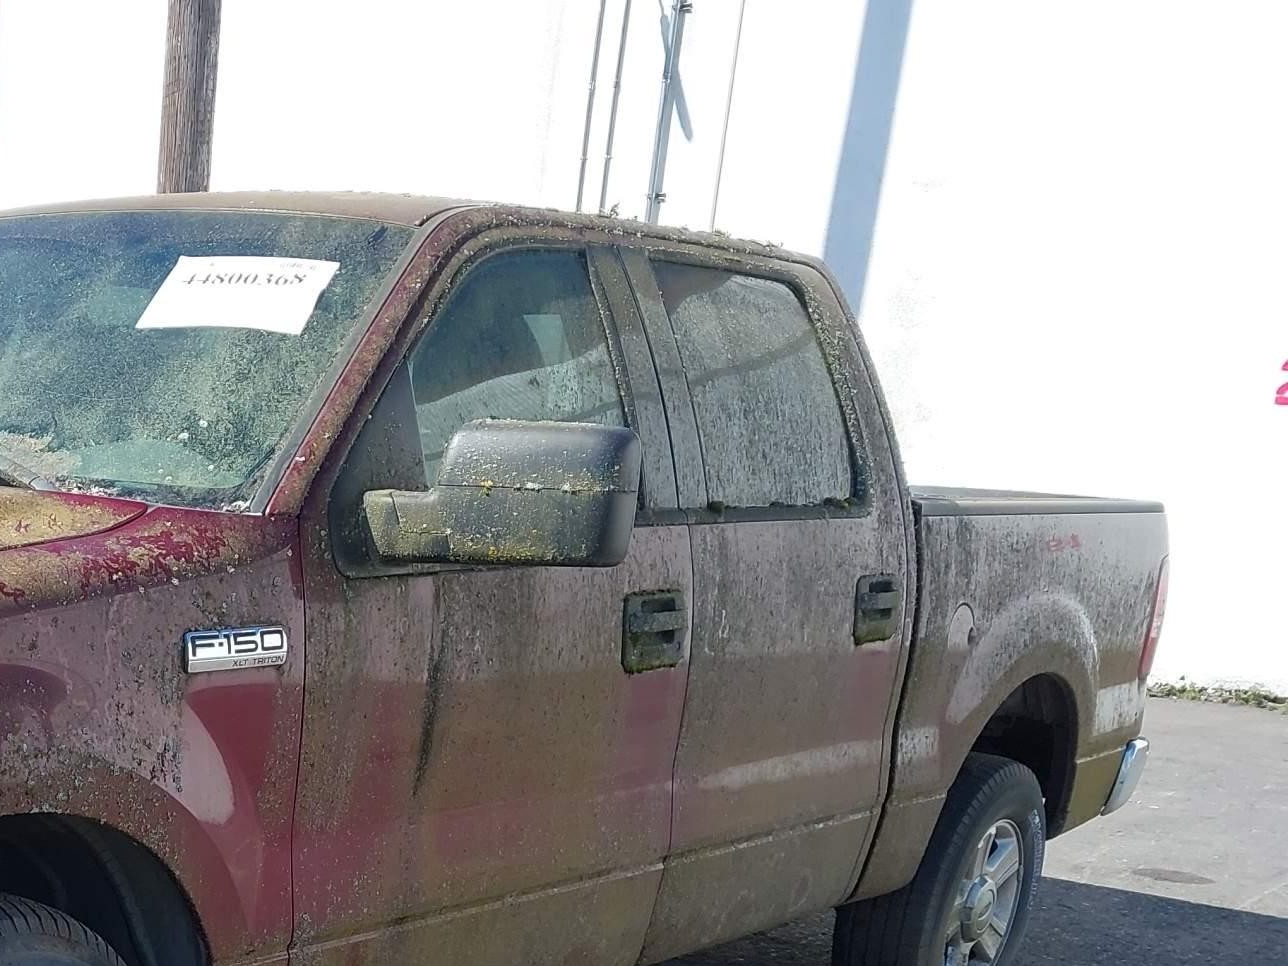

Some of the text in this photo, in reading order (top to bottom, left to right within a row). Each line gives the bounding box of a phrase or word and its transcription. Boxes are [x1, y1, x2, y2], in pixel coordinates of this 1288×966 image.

[182, 272, 307, 285] 44800368
[190, 629, 284, 657] F-150
[232, 655, 285, 667] XLT TRITON
